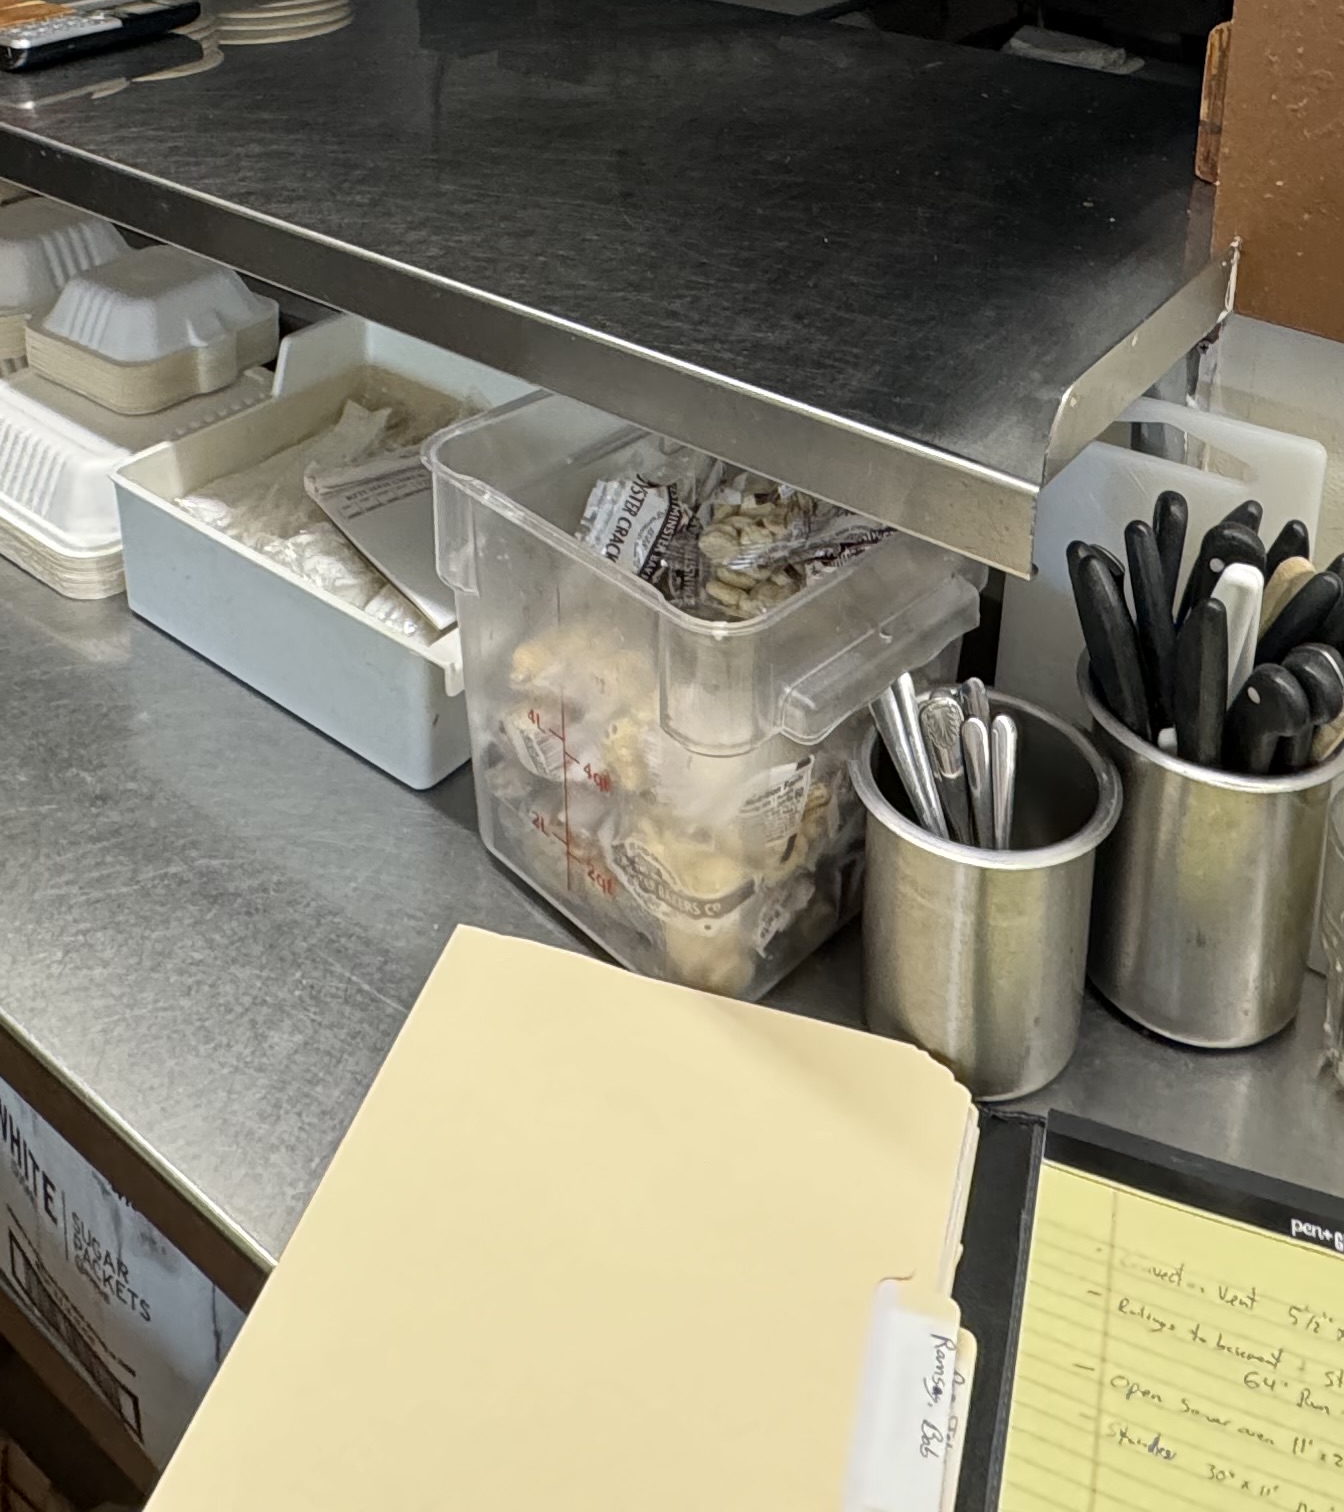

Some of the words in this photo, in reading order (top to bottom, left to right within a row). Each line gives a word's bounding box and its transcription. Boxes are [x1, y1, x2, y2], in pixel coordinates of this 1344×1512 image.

[72, 1212, 128, 1285] SUGAR
[74, 1232, 152, 1322] PACKETS
[1110, 1375, 1163, 1400] Open
